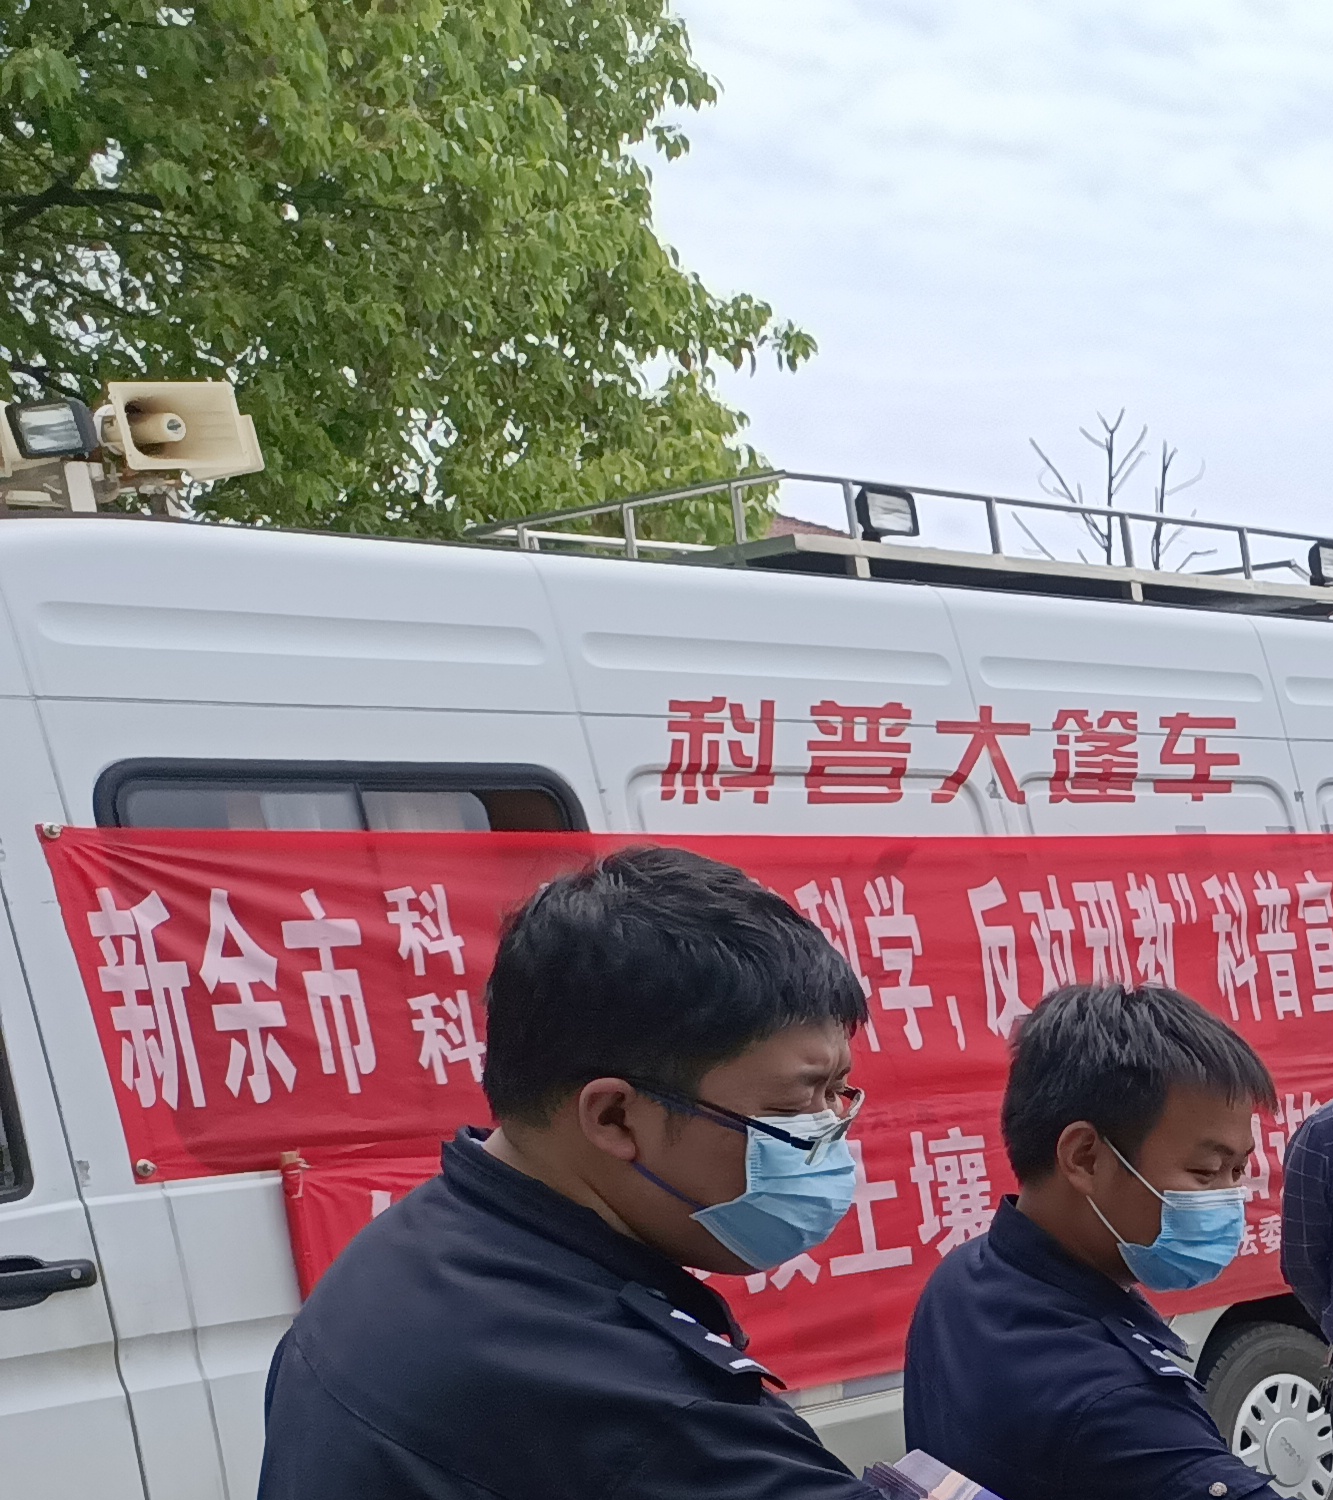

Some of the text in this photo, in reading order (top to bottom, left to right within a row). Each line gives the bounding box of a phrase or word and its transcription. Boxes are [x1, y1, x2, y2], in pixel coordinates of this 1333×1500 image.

[661, 695, 1241, 806] 科普大篷车
[88, 885, 380, 1111] 新余市
